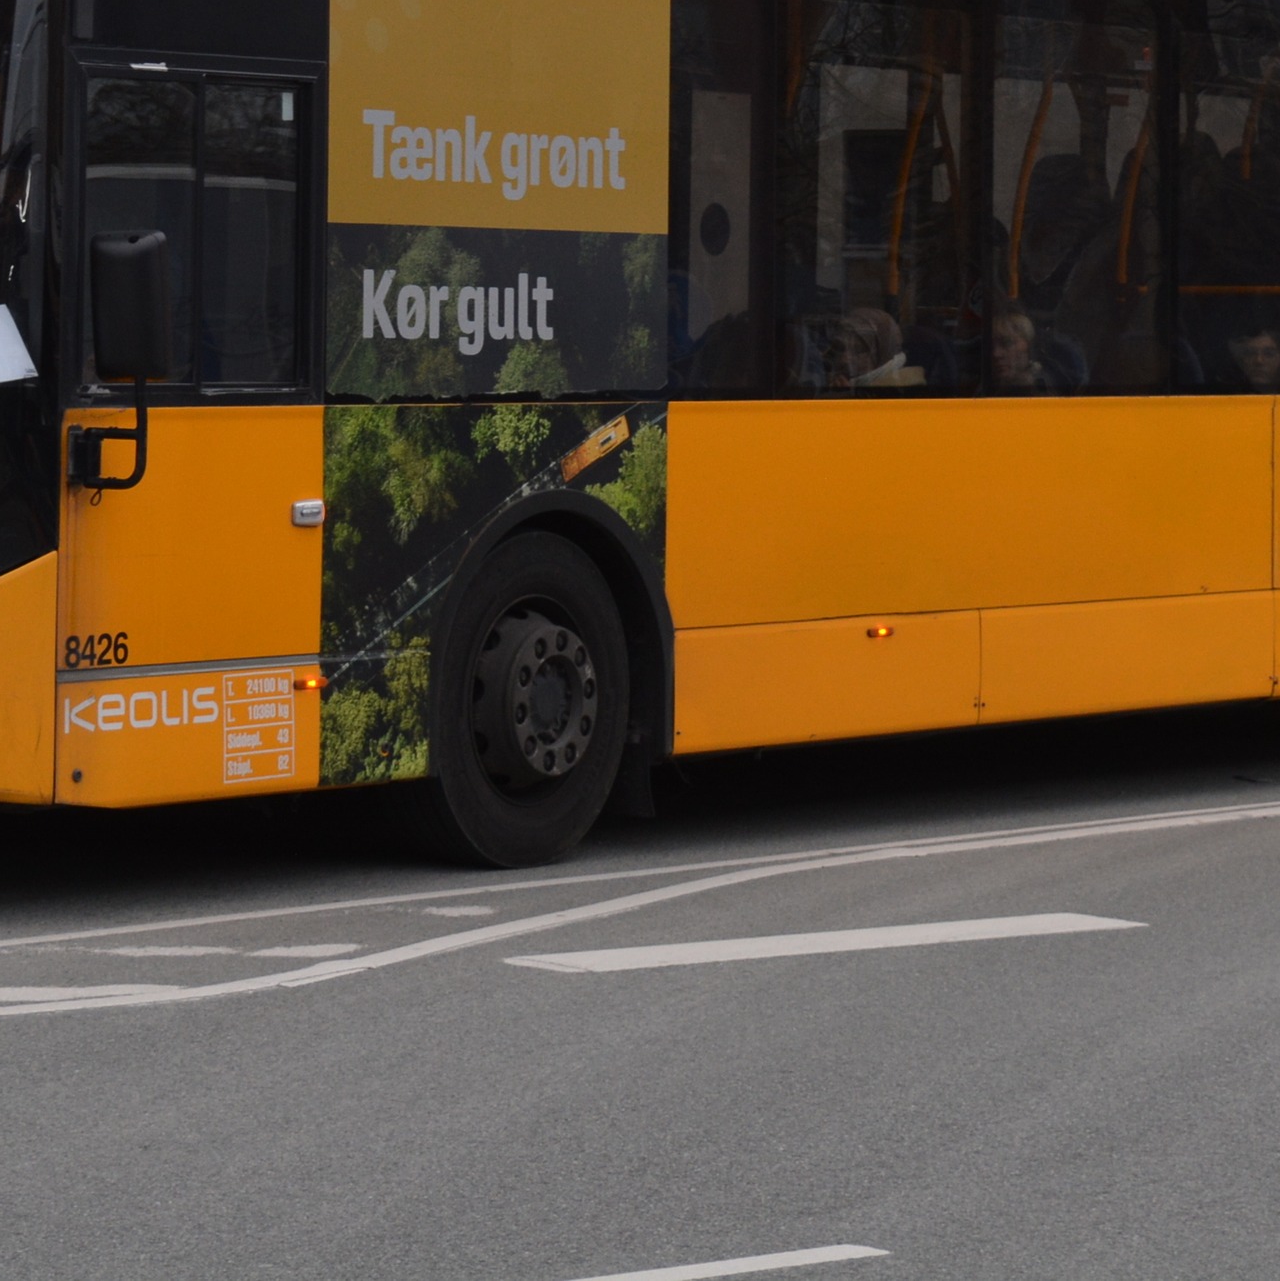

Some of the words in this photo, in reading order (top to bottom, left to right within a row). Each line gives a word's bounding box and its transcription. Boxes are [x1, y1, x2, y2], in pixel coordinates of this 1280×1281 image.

[363, 109, 492, 183] Tænk
[501, 127, 626, 201] grønt
[363, 269, 449, 339] Kør
[457, 272, 554, 355] gult
[65, 632, 129, 668] 8426
[247, 677, 276, 695] 24100
[278, 677, 289, 694] kg
[278, 703, 289, 719] kg
[227, 731, 262, 749] Siddepl.
[227, 756, 253, 776] Ståpl.
